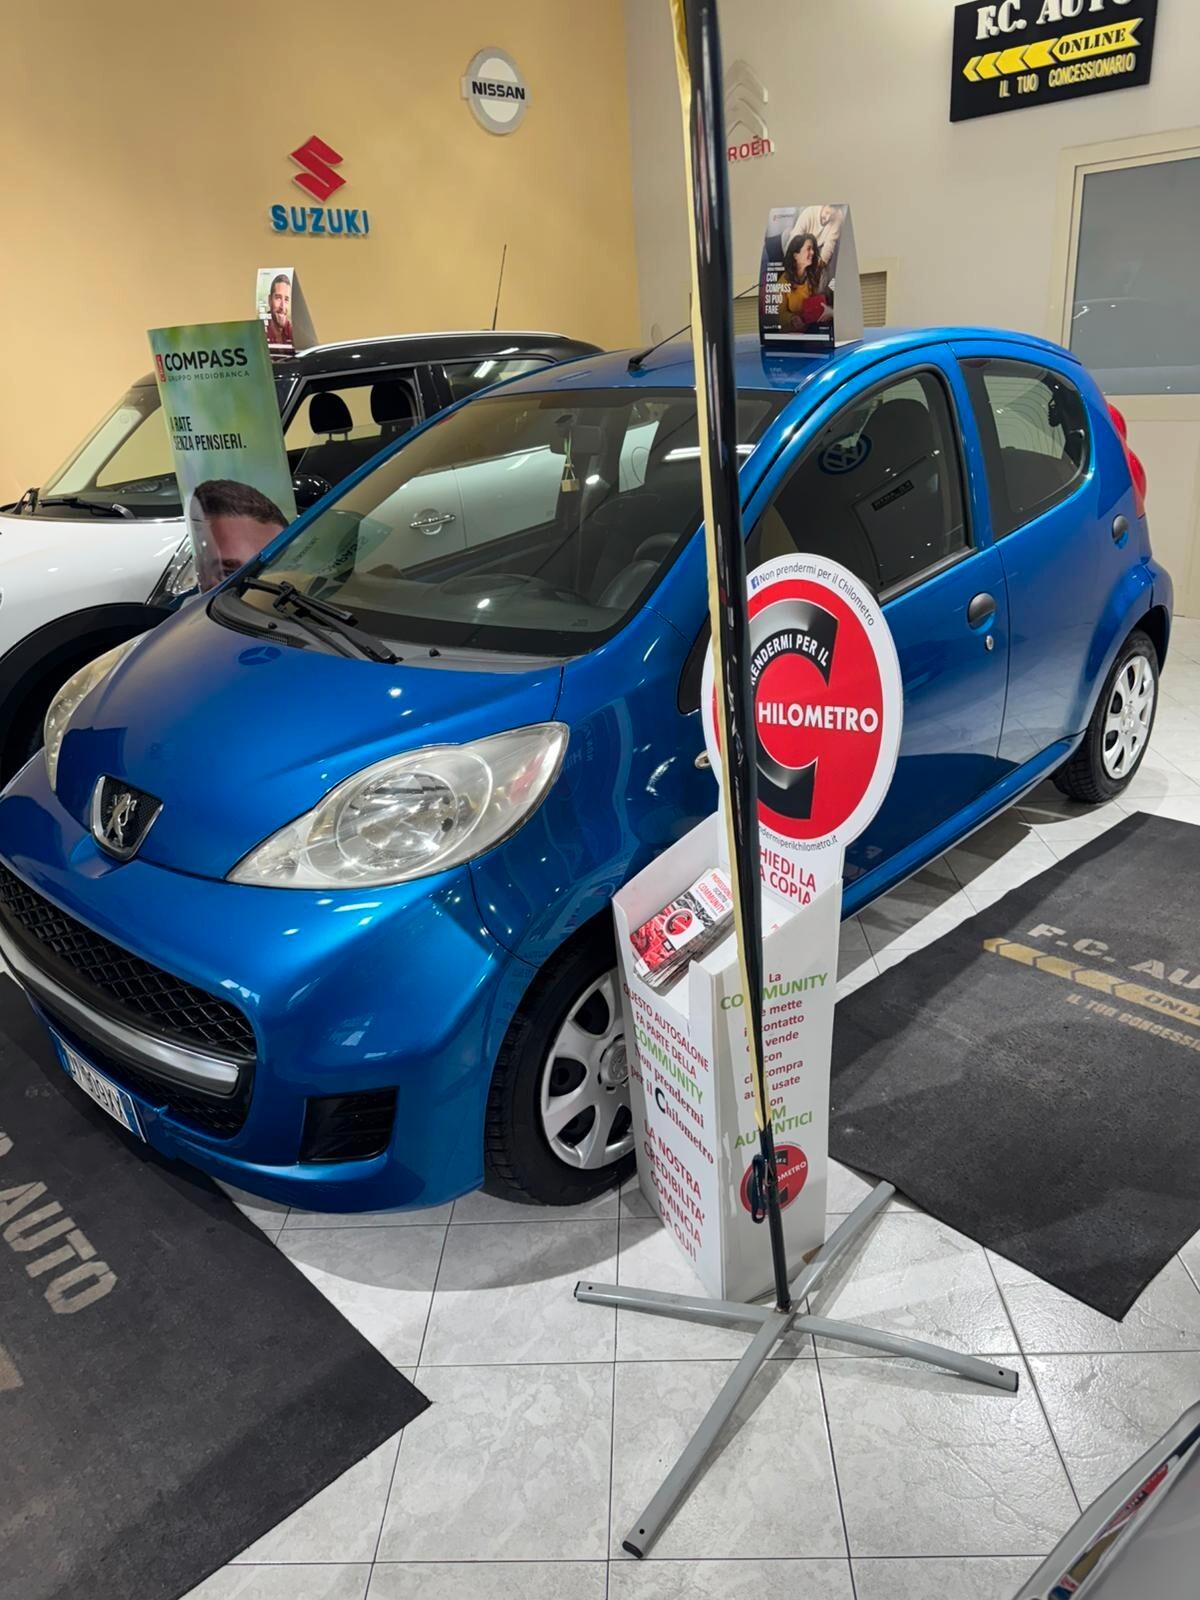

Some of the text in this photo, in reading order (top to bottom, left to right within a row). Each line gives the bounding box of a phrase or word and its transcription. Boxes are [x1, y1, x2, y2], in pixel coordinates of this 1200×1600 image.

[1059, 28, 1126, 55] ONLINE
[471, 81, 525, 100] NISSAN
[999, 52, 1136, 98] IL TUO CONCESSIONARIO
[270, 204, 370, 235] SUZUKI
[765, 304, 779, 315] FARE
[165, 348, 248, 371] COMPASS
[194, 371, 250, 379] MEDIOBANCA
[173, 433, 247, 451] SENZA PENSIERI.
[759, 563, 875, 626] Non prendermi per il Chilometro
[796, 634, 818, 656] PER
[817, 647, 829, 667] IL
[770, 871, 812, 905] COPIA
[799, 868, 816, 892] LA
[720, 972, 828, 1010] COMUNITY
[769, 973, 781, 983] La
[769, 999, 803, 1015] mette
[1065, 993, 1084, 1005] IL
[1085, 1000, 1118, 1018] TUO
[623, 983, 709, 1072] QUESTO AUTOSALONE
[765, 1031, 799, 1047] vende
[636, 1011, 697, 1080] FA PARTE DELLA
[634, 1024, 703, 1105] COMMUNITY
[634, 1042, 704, 1129] Non prendermi
[772, 1075, 801, 1091] usate
[770, 1095, 784, 1107] on
[646, 1079, 653, 1096] il
[655, 1087, 714, 1164] Chilometro
[734, 1111, 813, 1149] AUNTICI
[644, 1119, 702, 1200] LA NOSTRA
[644, 1141, 705, 1226] CREDIBILITA'
[650, 1170, 702, 1248] COMINCIA
[658, 1199, 697, 1262] DA QUI!
[0, 1181, 118, 1315] AUTO
